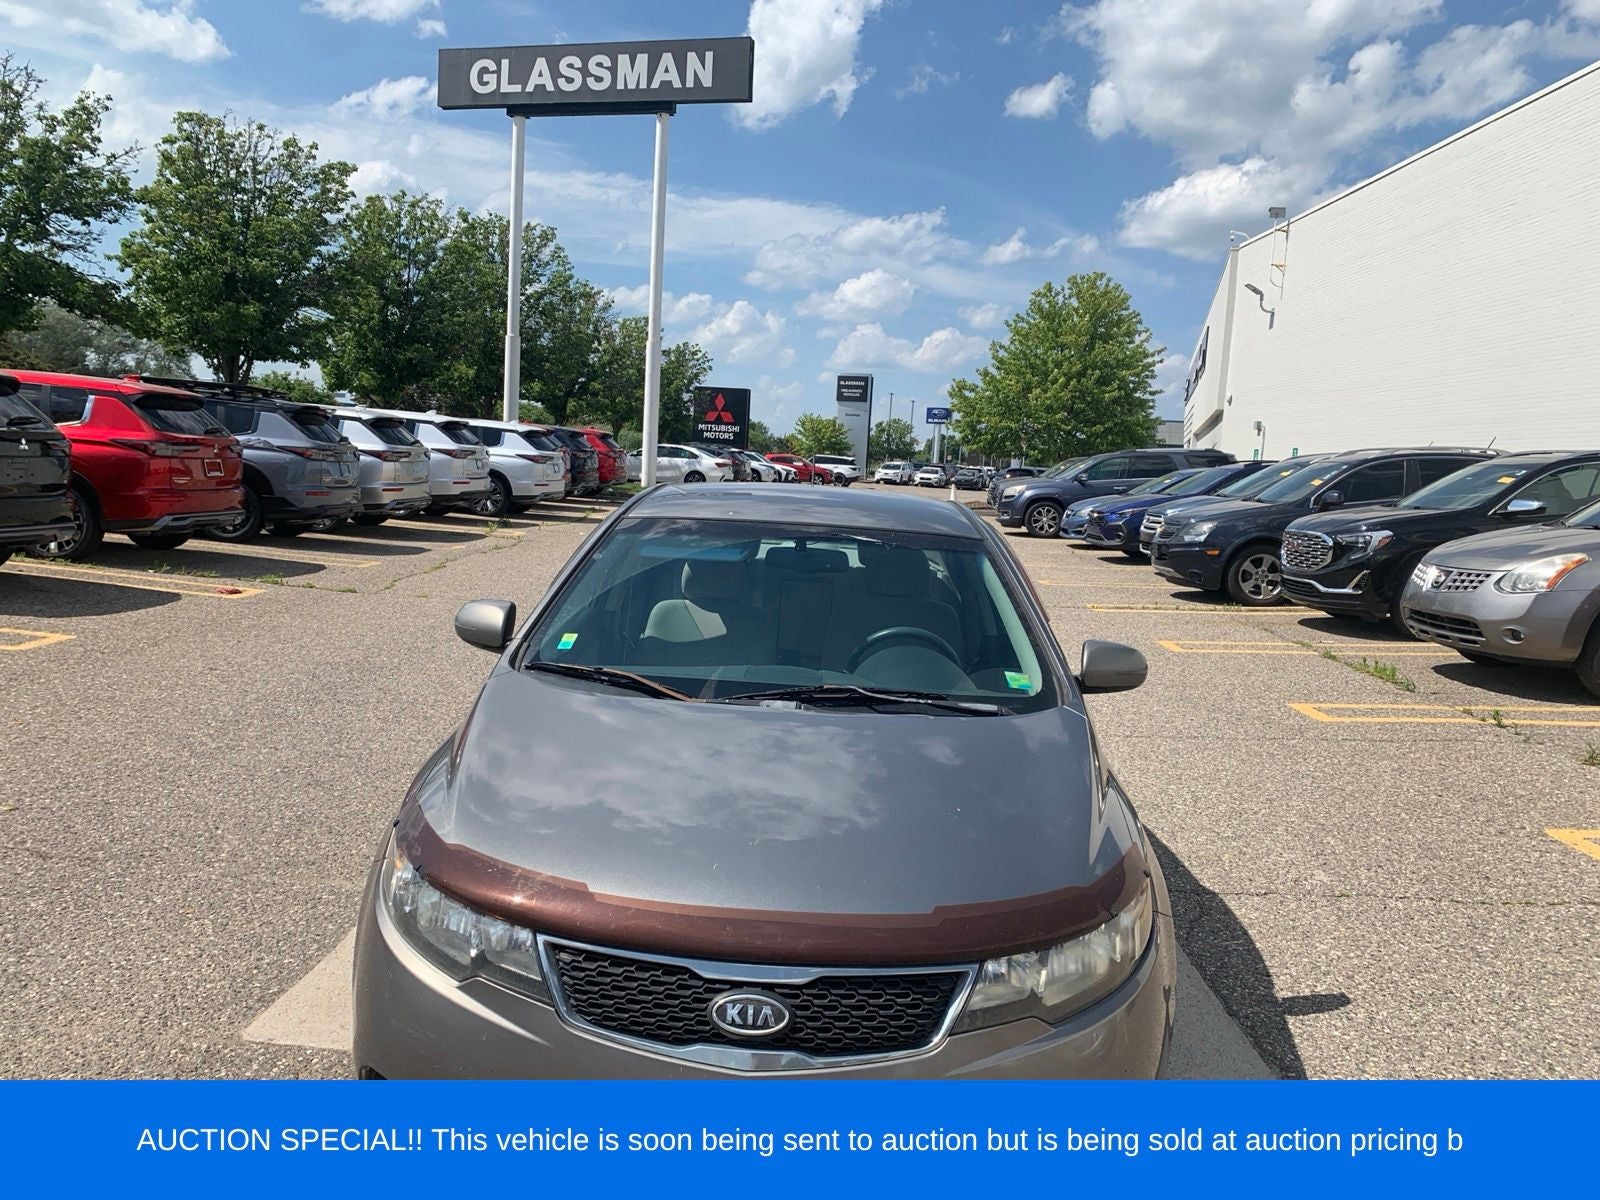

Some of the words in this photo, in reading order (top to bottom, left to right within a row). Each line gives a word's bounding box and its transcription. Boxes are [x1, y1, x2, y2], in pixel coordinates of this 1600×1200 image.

[469, 51, 714, 94] GLASSMAN
[698, 423, 740, 432] MITSUBISHI
[703, 431, 734, 440] MOTORS
[725, 1003, 776, 1027] KIA
